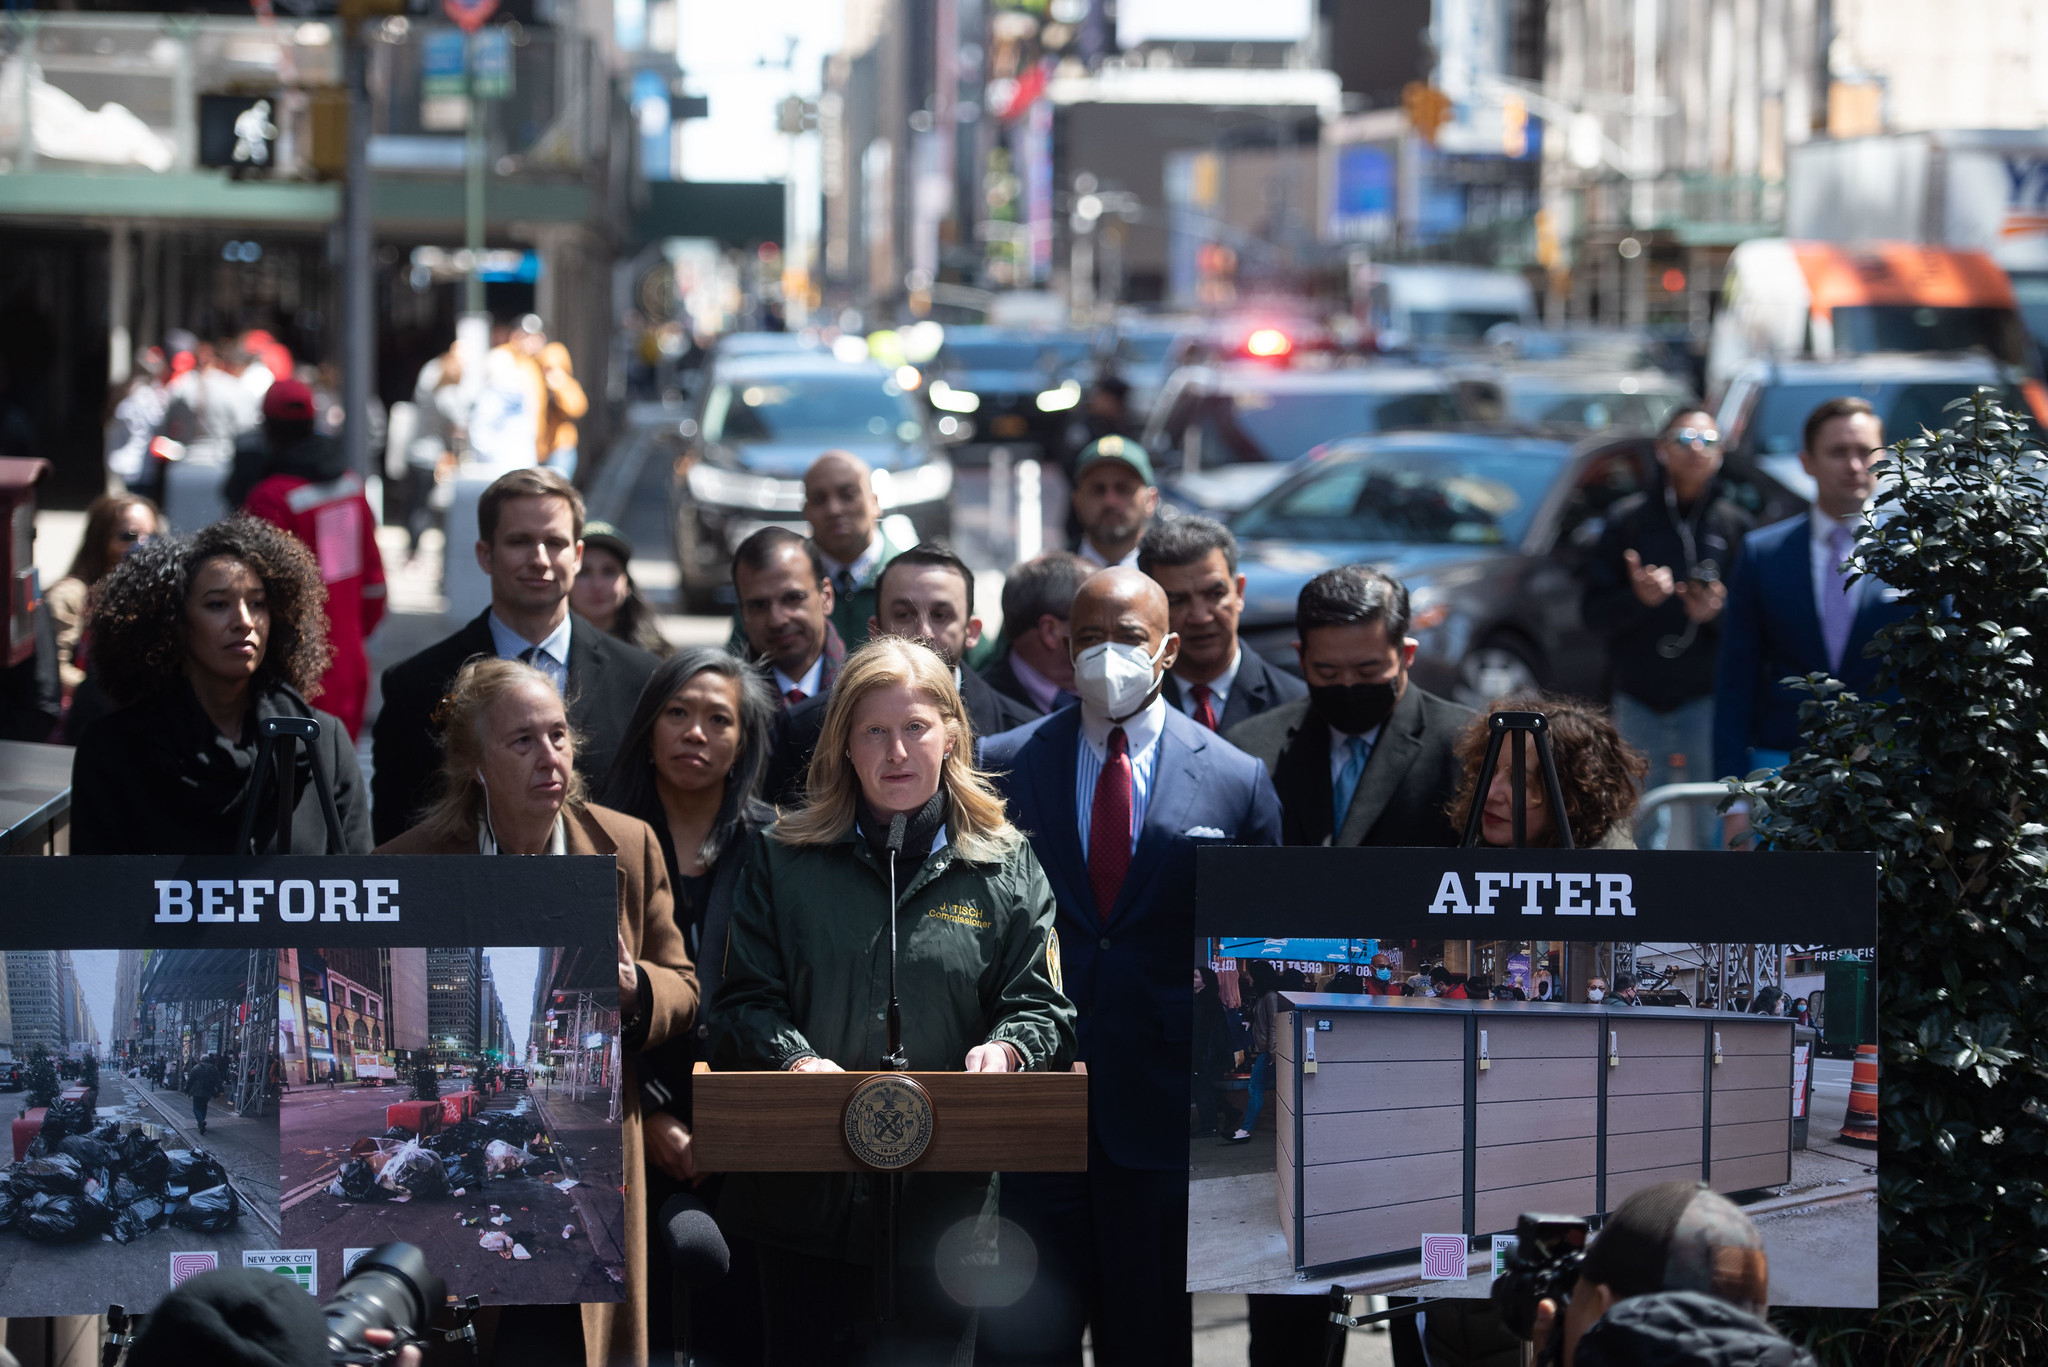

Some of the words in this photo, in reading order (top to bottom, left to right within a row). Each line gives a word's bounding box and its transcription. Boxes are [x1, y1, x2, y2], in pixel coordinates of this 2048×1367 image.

[154, 879, 400, 922] BEFORE
[1429, 872, 1636, 915] AFTER
[929, 909, 992, 928] Commissioner
[940, 902, 948, 912] J.
[953, 904, 983, 918] TISCH
[247, 1256, 266, 1264] NEW
[270, 1255, 291, 1263] YORK
[294, 1254, 312, 1262] CITY
